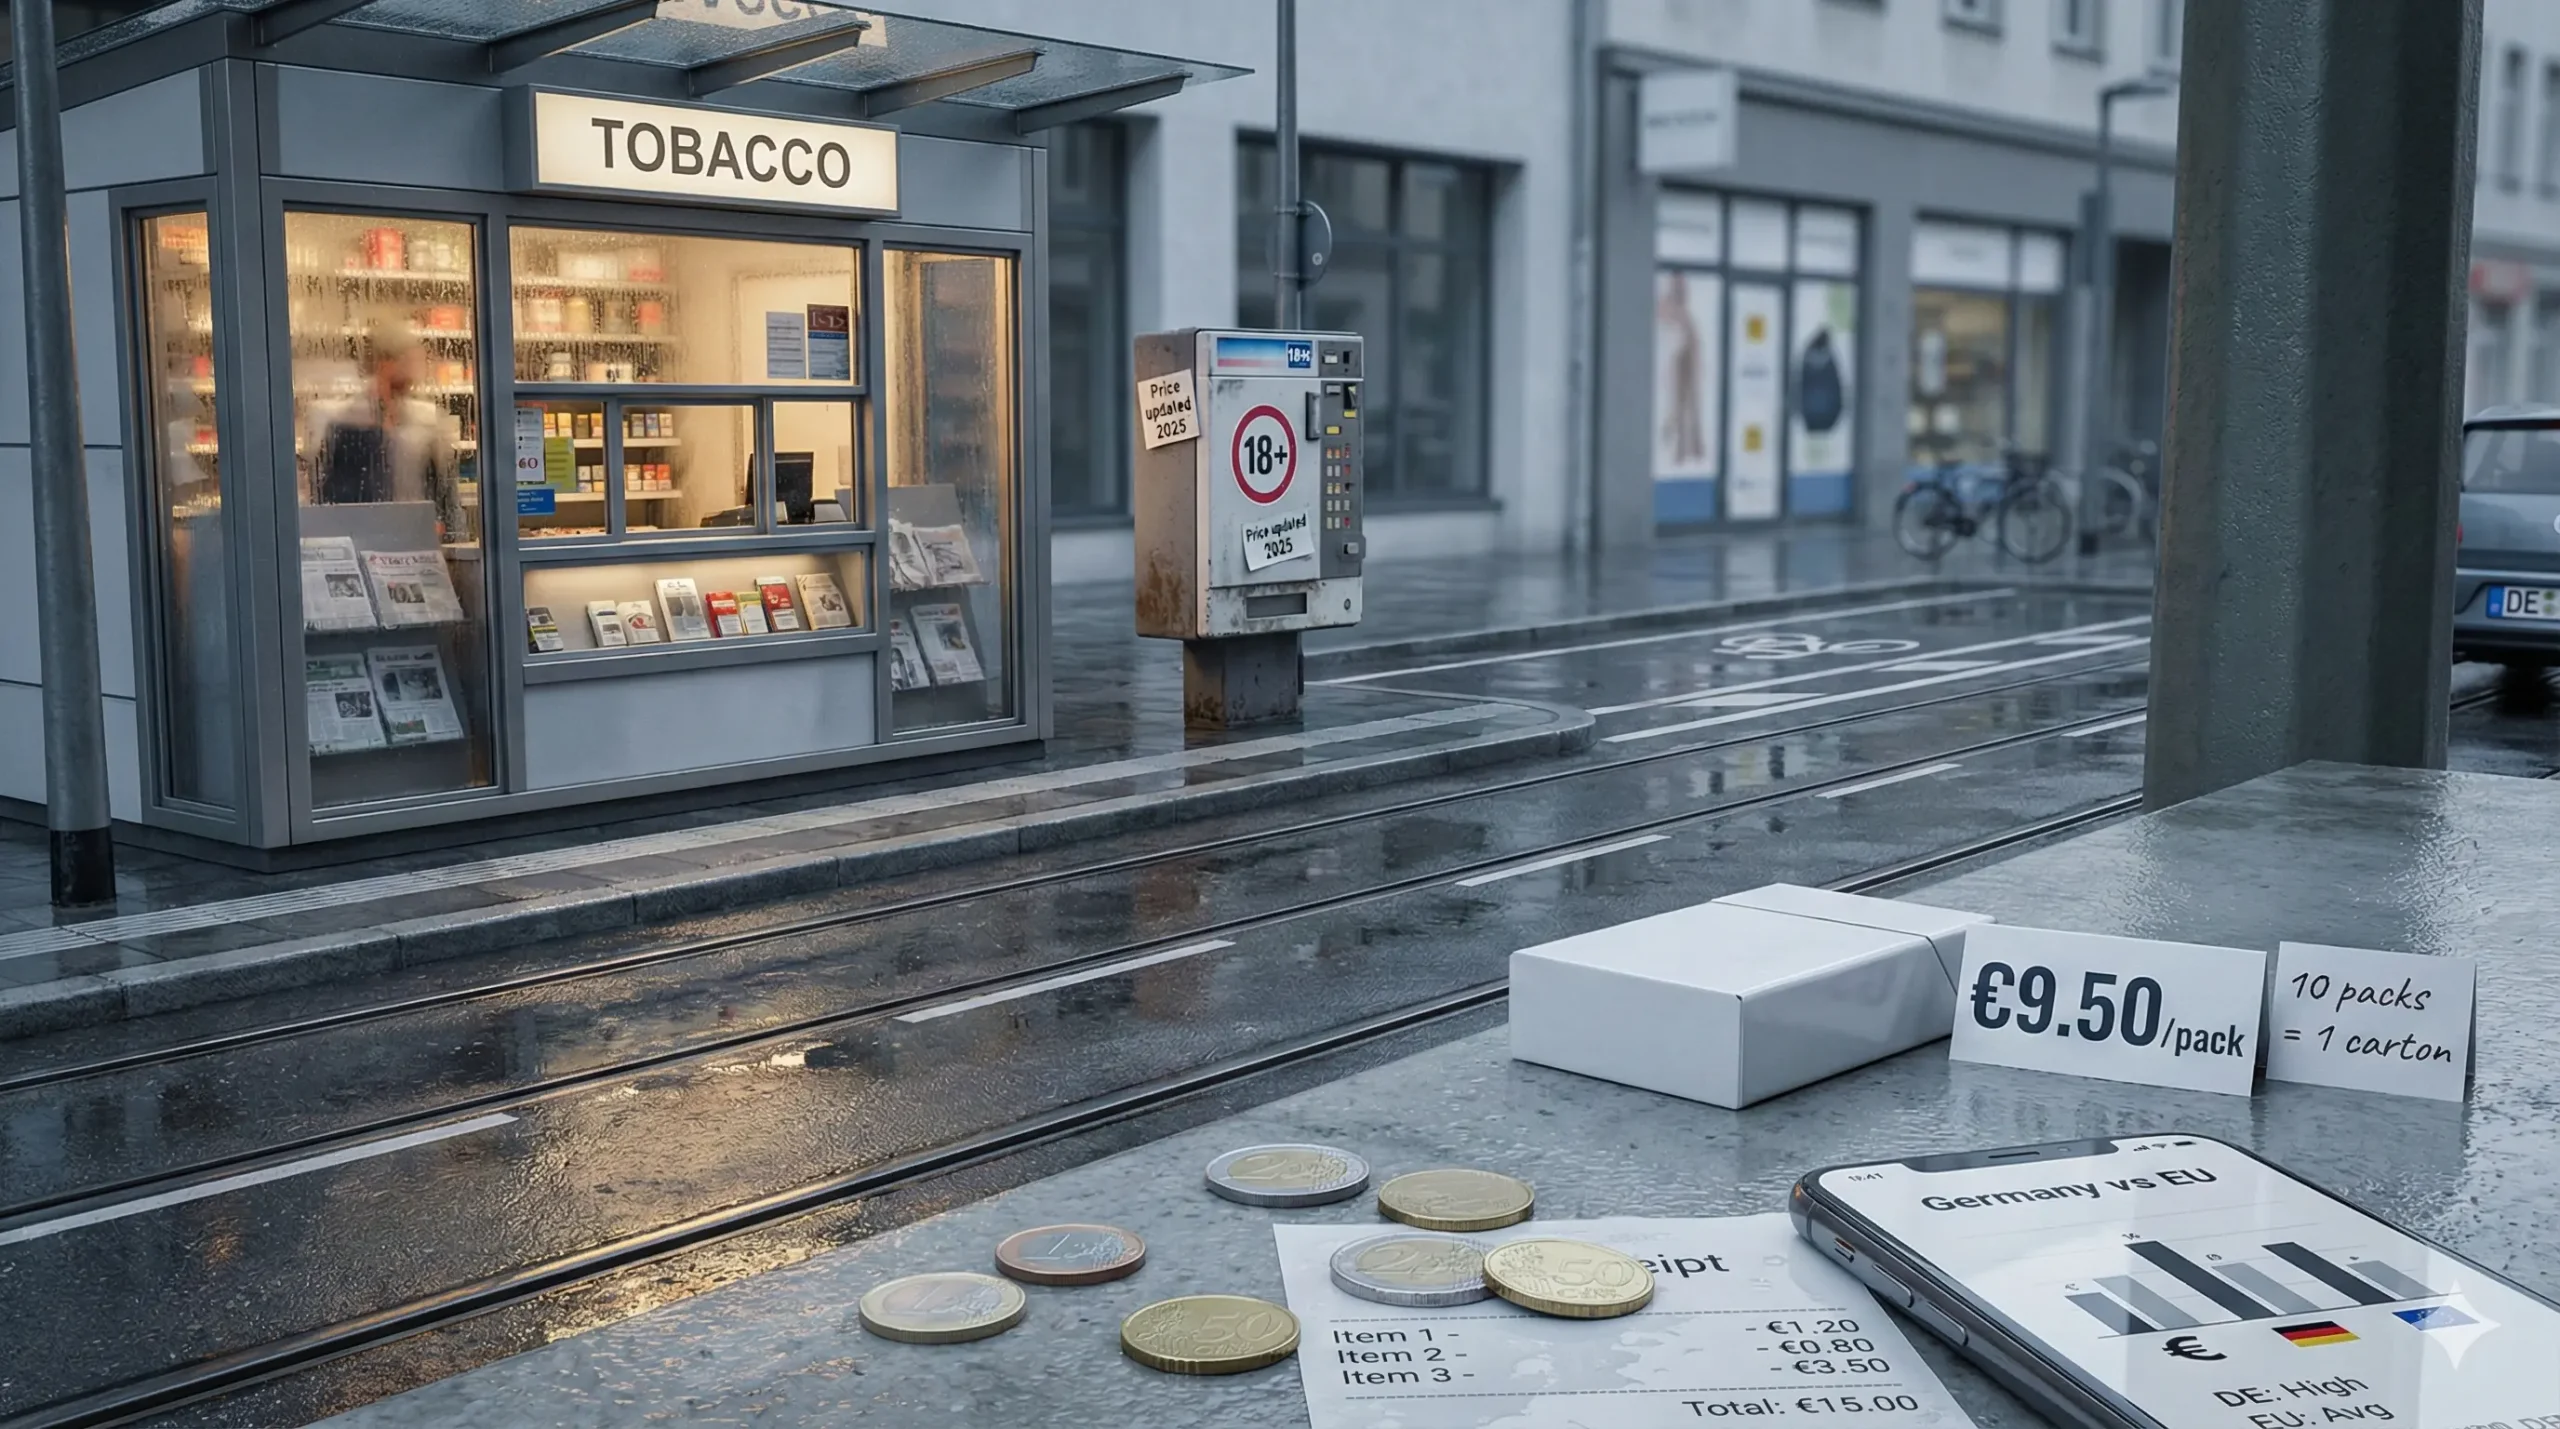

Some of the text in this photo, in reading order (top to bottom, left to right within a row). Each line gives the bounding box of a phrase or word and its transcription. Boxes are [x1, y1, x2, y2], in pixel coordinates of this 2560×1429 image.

[592, 117, 850, 189] TOBACCO
[1150, 381, 1180, 398] Price
[1156, 418, 1187, 439] 2025
[1244, 434, 1288, 475] 18+
[1264, 537, 1293, 559] 2025
[2506, 589, 2540, 614] DE
[2292, 972, 2432, 1013] 10 packs
[2317, 1026, 2334, 1052] 1
[2346, 1033, 2452, 1063] carton
[1922, 1168, 2218, 1211] Germany vs EU
[1638, 1253, 1729, 1279] eipt
[1333, 1330, 1407, 1344] Item
[1418, 1328, 1433, 1341] 1
[1766, 1319, 1860, 1335] €1.20
[1338, 1350, 1412, 1364] Item
[1423, 1347, 1446, 1361] 2
[1779, 1338, 1875, 1354] €0.80
[2162, 1335, 2228, 1361] €
[1343, 1370, 1420, 1385] Item
[1430, 1367, 1452, 1382] 3
[1792, 1358, 1890, 1375] €3.50
[2212, 1376, 2369, 1408] DE: High
[1682, 1395, 1919, 1417] Total: €15.00
[2247, 1404, 2395, 1429] EU: Avg
